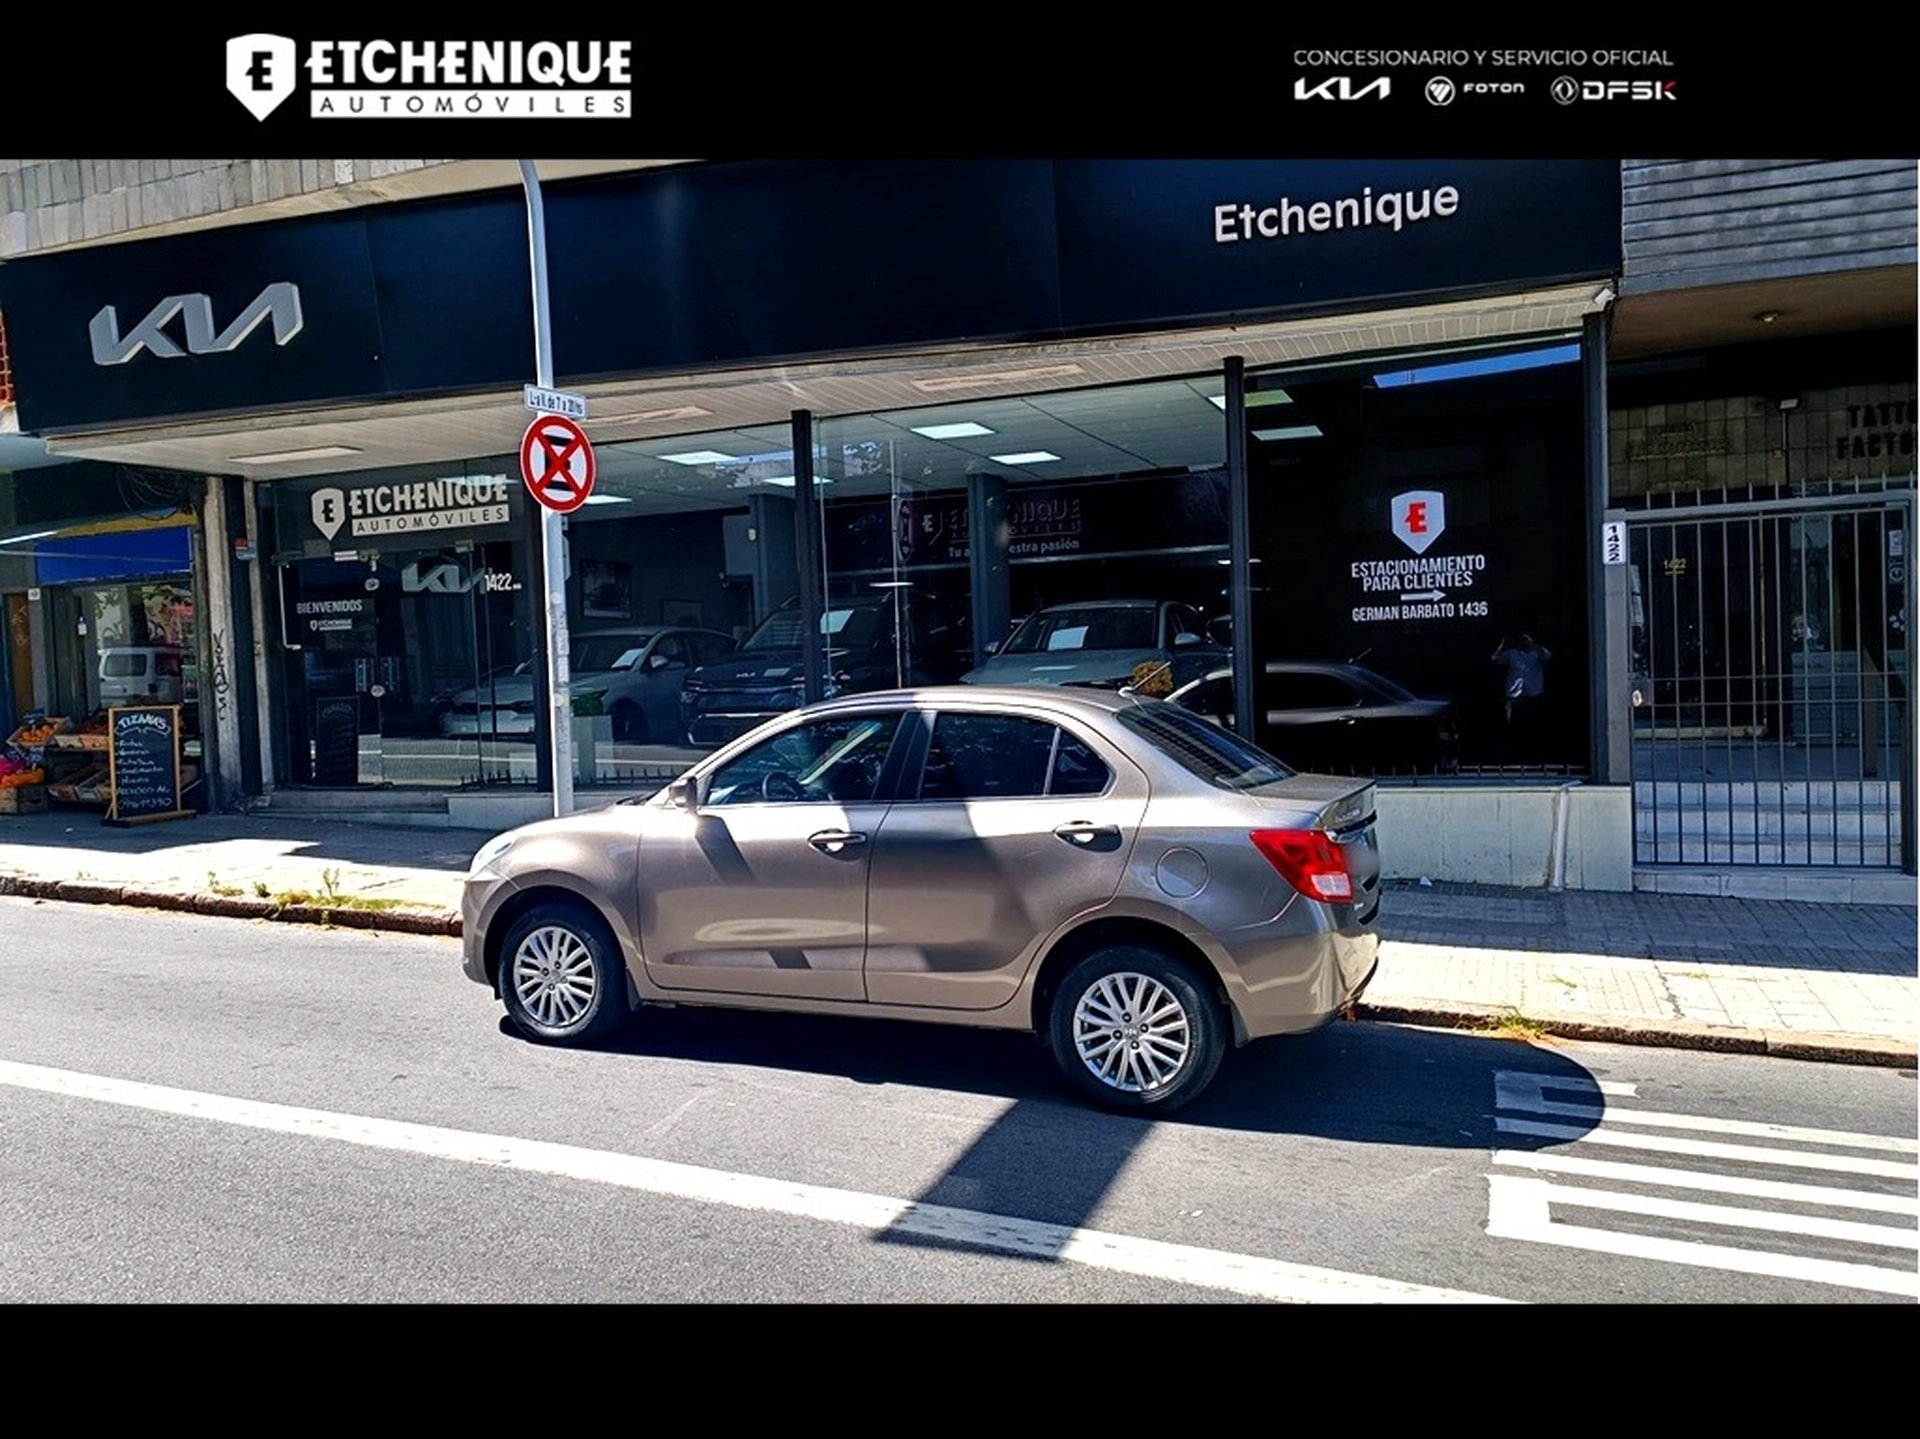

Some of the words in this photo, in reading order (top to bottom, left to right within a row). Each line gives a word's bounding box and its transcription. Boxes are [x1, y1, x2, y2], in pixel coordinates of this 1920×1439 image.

[1214, 185, 1460, 243] Etchenique
[89, 282, 304, 366] KIA
[349, 473, 508, 517] ETCHENIQUE
[356, 508, 505, 533] AUTOMÓVILES
[1008, 543, 1038, 554] estra
[1041, 538, 1080, 554] pasión
[1607, 525, 1620, 562] 1422
[1351, 554, 1486, 579] ESTACIONAMIENTO
[485, 573, 512, 592] 1422
[1363, 575, 1401, 592] PARA
[1404, 570, 1473, 590] CLIENTES
[296, 598, 363, 615] BIENVENIDOS
[1352, 605, 1399, 622] GERMAN
[1402, 603, 1454, 620] BARBATO
[1458, 601, 1488, 617] 1436
